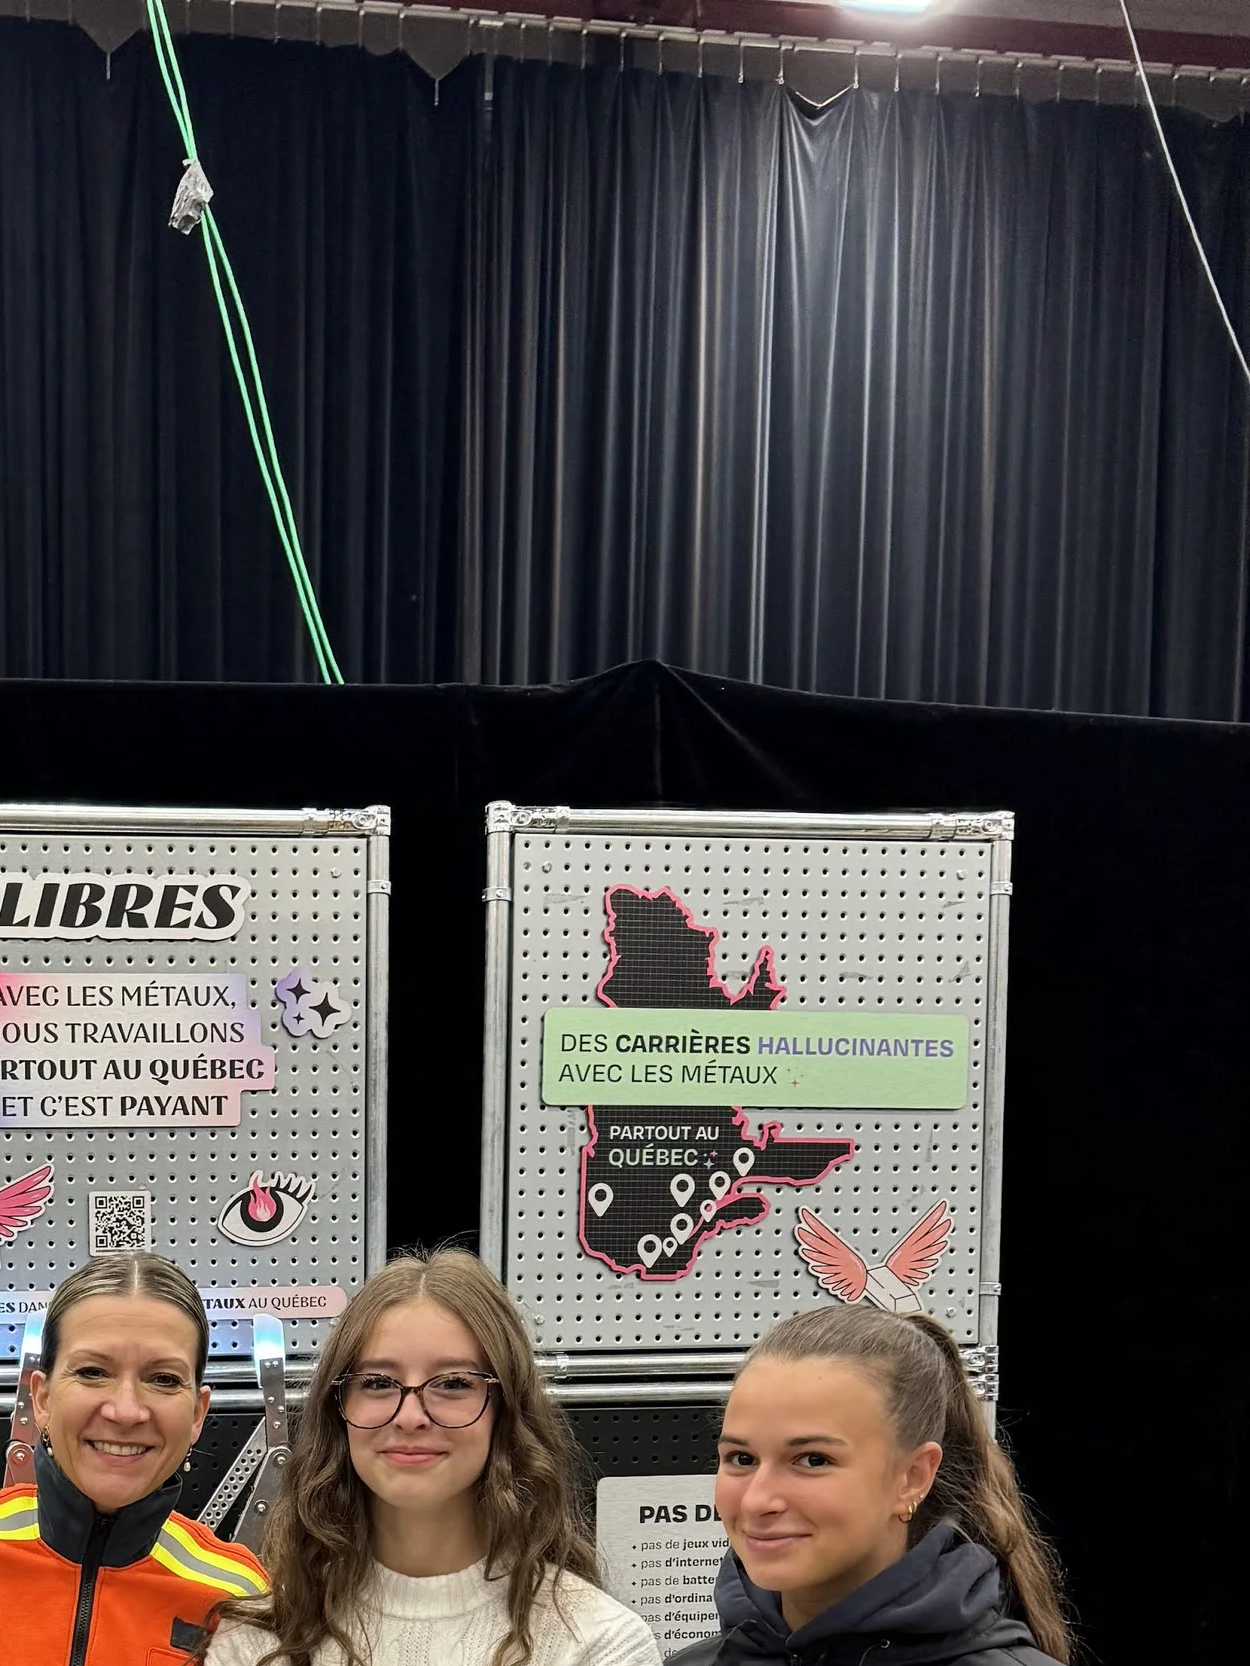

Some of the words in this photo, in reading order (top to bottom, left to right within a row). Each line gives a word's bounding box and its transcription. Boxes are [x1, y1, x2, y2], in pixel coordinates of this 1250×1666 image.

[66, 985, 114, 1007] LES
[120, 980, 237, 1011] MÉTAUX,
[65, 1022, 245, 1045] TRAVAILLONS
[561, 1033, 608, 1053] DES
[615, 1028, 751, 1055] CARRIÈRES
[758, 1037, 954, 1058] HALLUCINANTES
[102, 1059, 142, 1082] AU
[149, 1054, 265, 1085] QUÉBEC
[559, 1064, 623, 1084] AVEC
[630, 1064, 674, 1084] LES
[681, 1060, 778, 1085] MÉTAUX
[1, 1095, 35, 1118] ET
[120, 1095, 228, 1117] PAYANT
[609, 1126, 690, 1141] PARTOUT
[694, 1126, 719, 1141] AU
[608, 1144, 698, 1168] QUÉBEC
[19, 1302, 48, 1313] DAN
[203, 1298, 246, 1309] TAUX
[248, 1297, 268, 1309] AU
[271, 1294, 327, 1310] QUÉBEC
[639, 1505, 688, 1524] PAS
[641, 1541, 662, 1552] pas
[665, 1539, 680, 1550] de
[682, 1539, 709, 1551] jeux
[712, 1537, 730, 1548] vid
[641, 1559, 662, 1570] pas
[640, 1577, 662, 1588] pas
[665, 1575, 680, 1586] de
[682, 1575, 716, 1586] batte
[640, 1595, 661, 1606] pas
[664, 1593, 713, 1604] d'ordina
